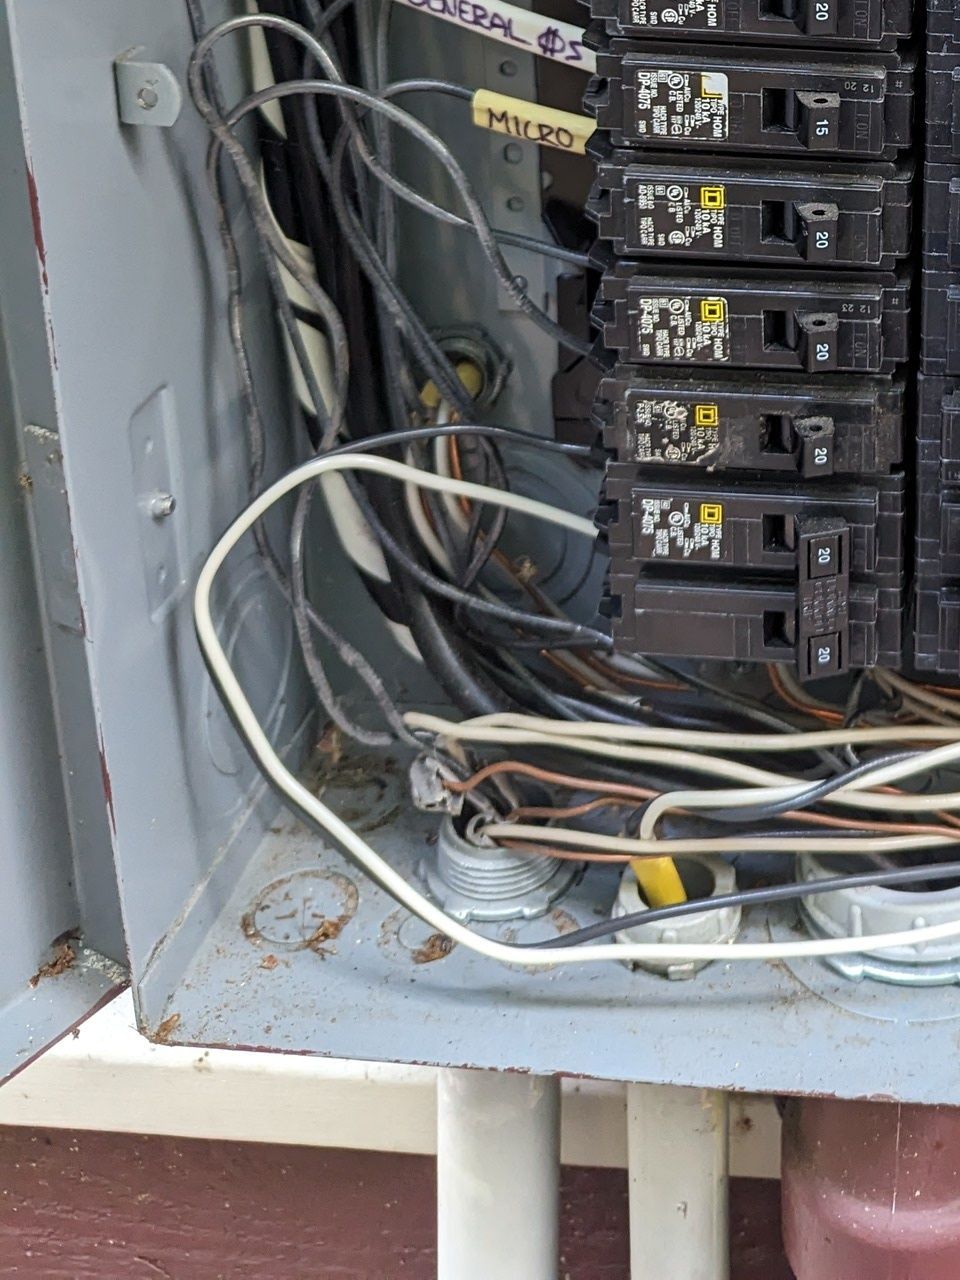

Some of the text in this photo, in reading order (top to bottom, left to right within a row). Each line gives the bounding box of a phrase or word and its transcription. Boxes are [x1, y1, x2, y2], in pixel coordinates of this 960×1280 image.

[707, 4, 717, 26] HOM
[816, 3, 829, 21] 20
[638, 72, 651, 109] DP-4075
[488, 107, 574, 148] MICRO
[713, 116, 722, 137] HOM
[816, 119, 829, 136] 15
[713, 226, 723, 248] HOM
[816, 231, 829, 249] 20
[640, 298, 653, 334] DP-4075
[816, 343, 829, 361] 20
[815, 448, 828, 465] 20
[818, 547, 830, 563] 20
[818, 646, 830, 663] 20
